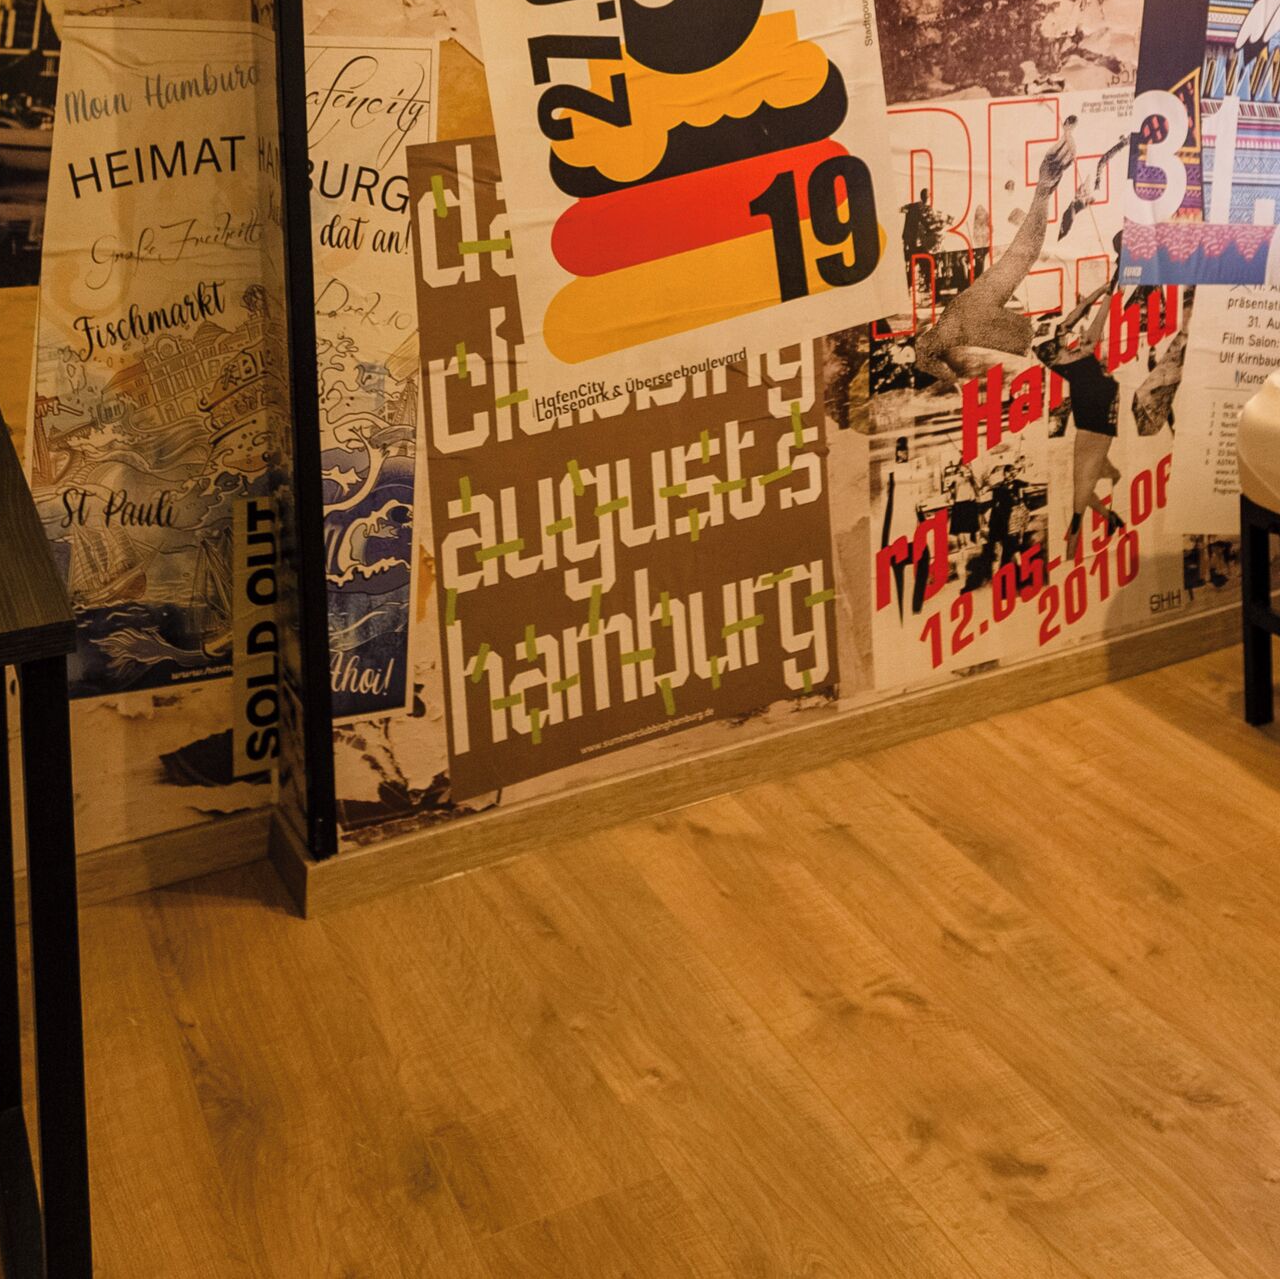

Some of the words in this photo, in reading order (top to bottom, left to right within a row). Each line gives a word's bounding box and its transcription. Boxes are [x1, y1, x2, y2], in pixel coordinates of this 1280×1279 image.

[65, 87, 130, 125] Moin
[67, 135, 246, 199] HEIMAT
[320, 213, 370, 250] dat
[372, 220, 413, 255] an!
[747, 154, 882, 303] 19
[73, 281, 226, 363] Fischmarkt
[1222, 332, 1245, 346] Film
[612, 384, 623, 399] &
[624, 346, 748, 394] Überseeboulevard
[1219, 351, 1235, 365] Ulf
[535, 379, 606, 411] HafenCity
[60, 487, 97, 529] St
[103, 488, 176, 529] Pauli
[246, 500, 279, 607] OUT
[1038, 529, 1140, 648] 2010
[1149, 588, 1182, 615] SHH
[447, 559, 832, 756] hamburg
[246, 620, 280, 760] SOLD
